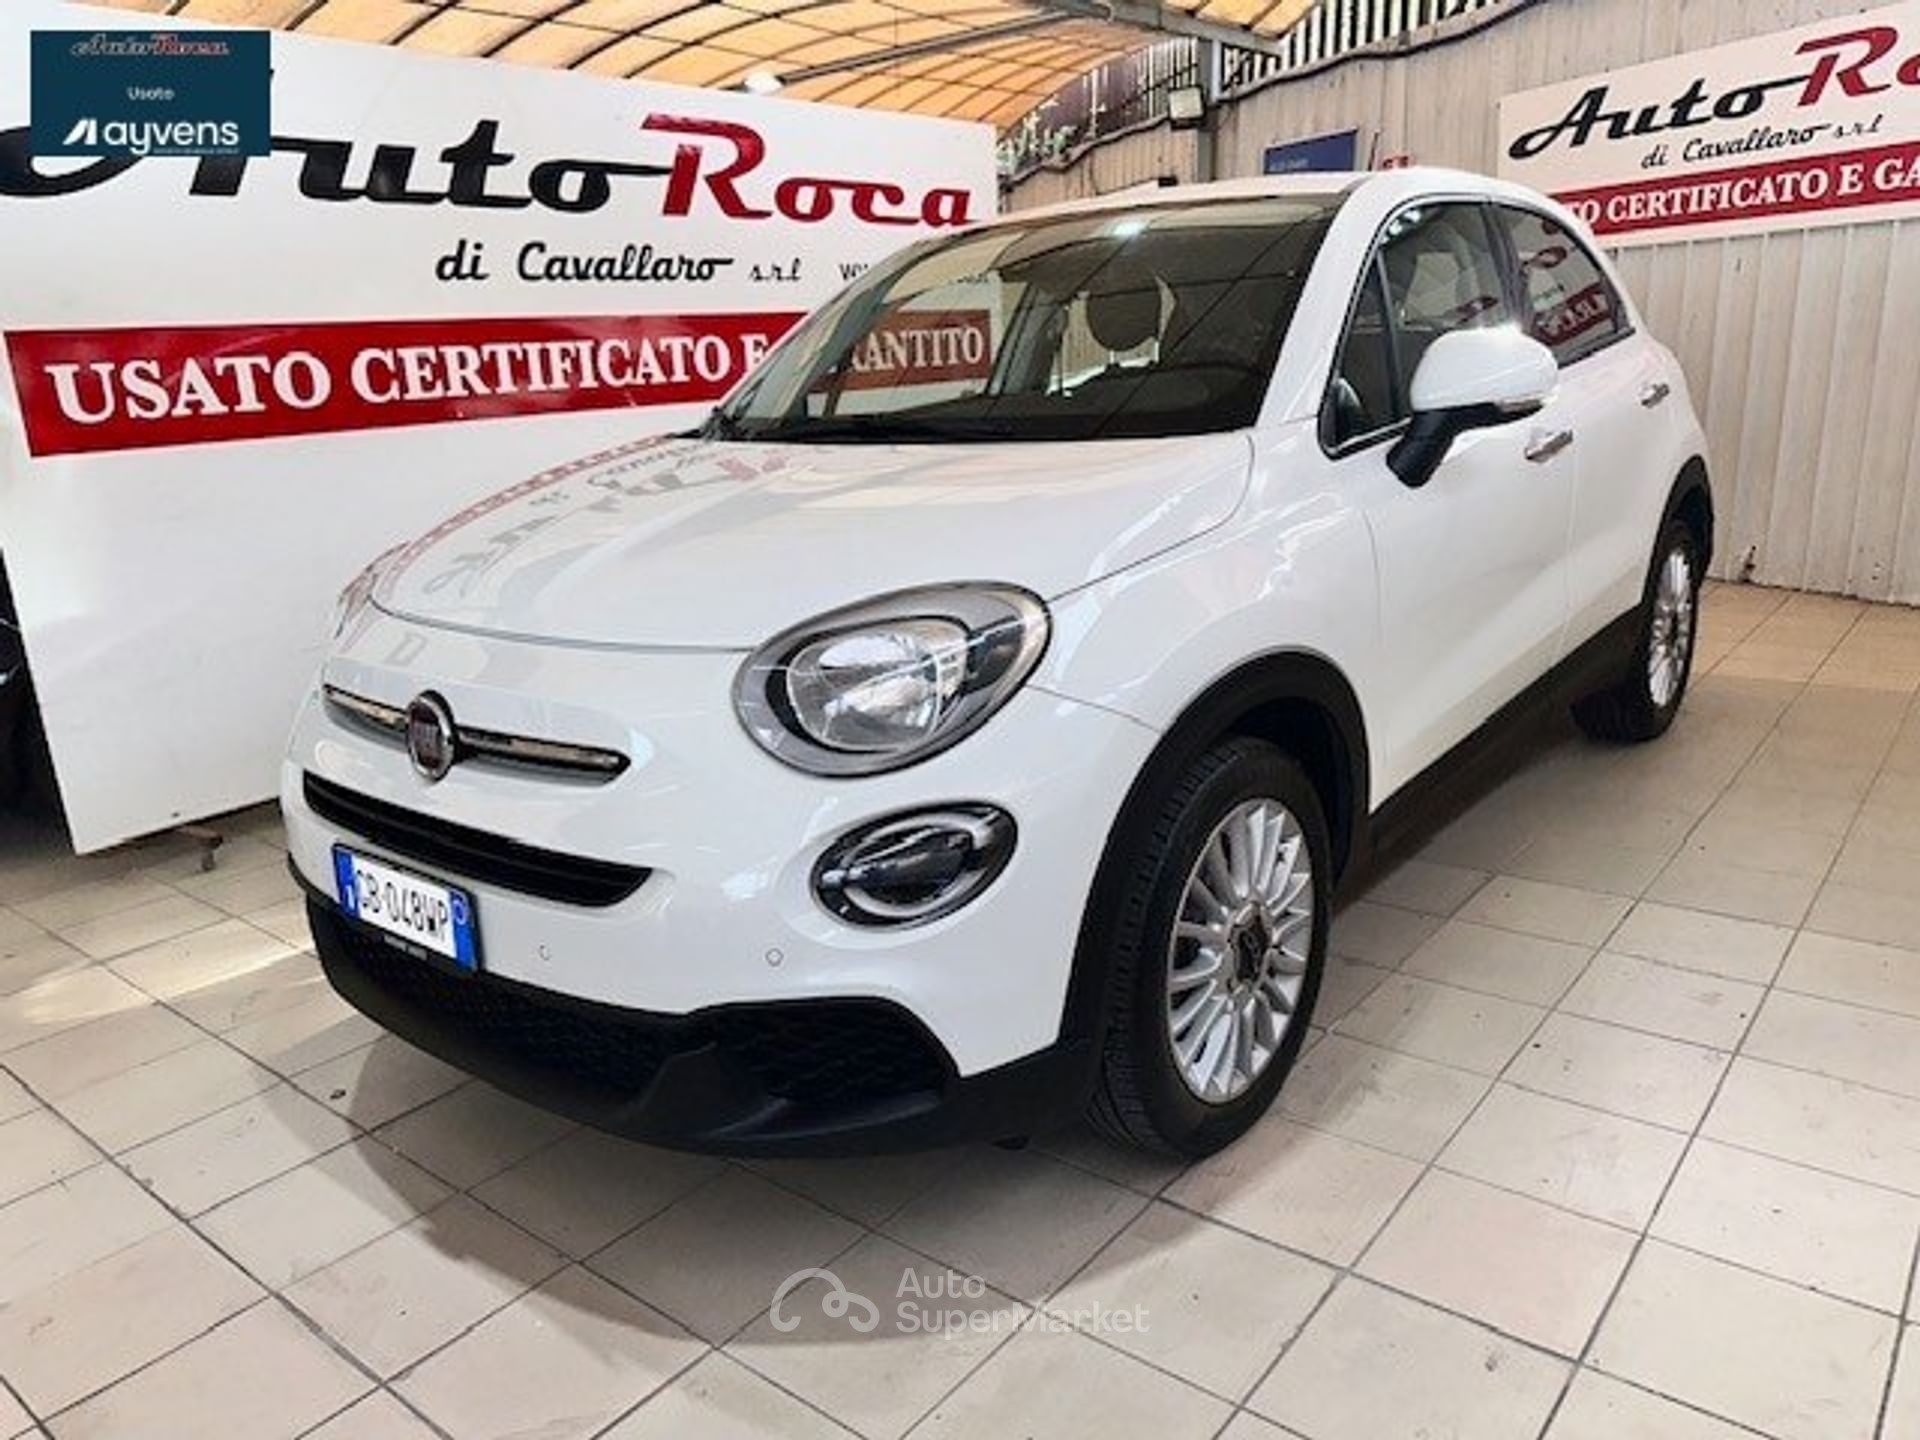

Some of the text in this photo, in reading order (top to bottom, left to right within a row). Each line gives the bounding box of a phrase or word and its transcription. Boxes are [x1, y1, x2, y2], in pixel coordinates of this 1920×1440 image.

[1640, 143, 1669, 170] di
[1682, 122, 1833, 163] Cavallaro
[1607, 169, 1829, 222] CERTIFICATO
[1836, 163, 1865, 195] E
[435, 239, 490, 282] di
[517, 240, 734, 284] Cavallaro
[45, 352, 332, 424] USATO
[350, 334, 732, 404] CERTIFICATO
